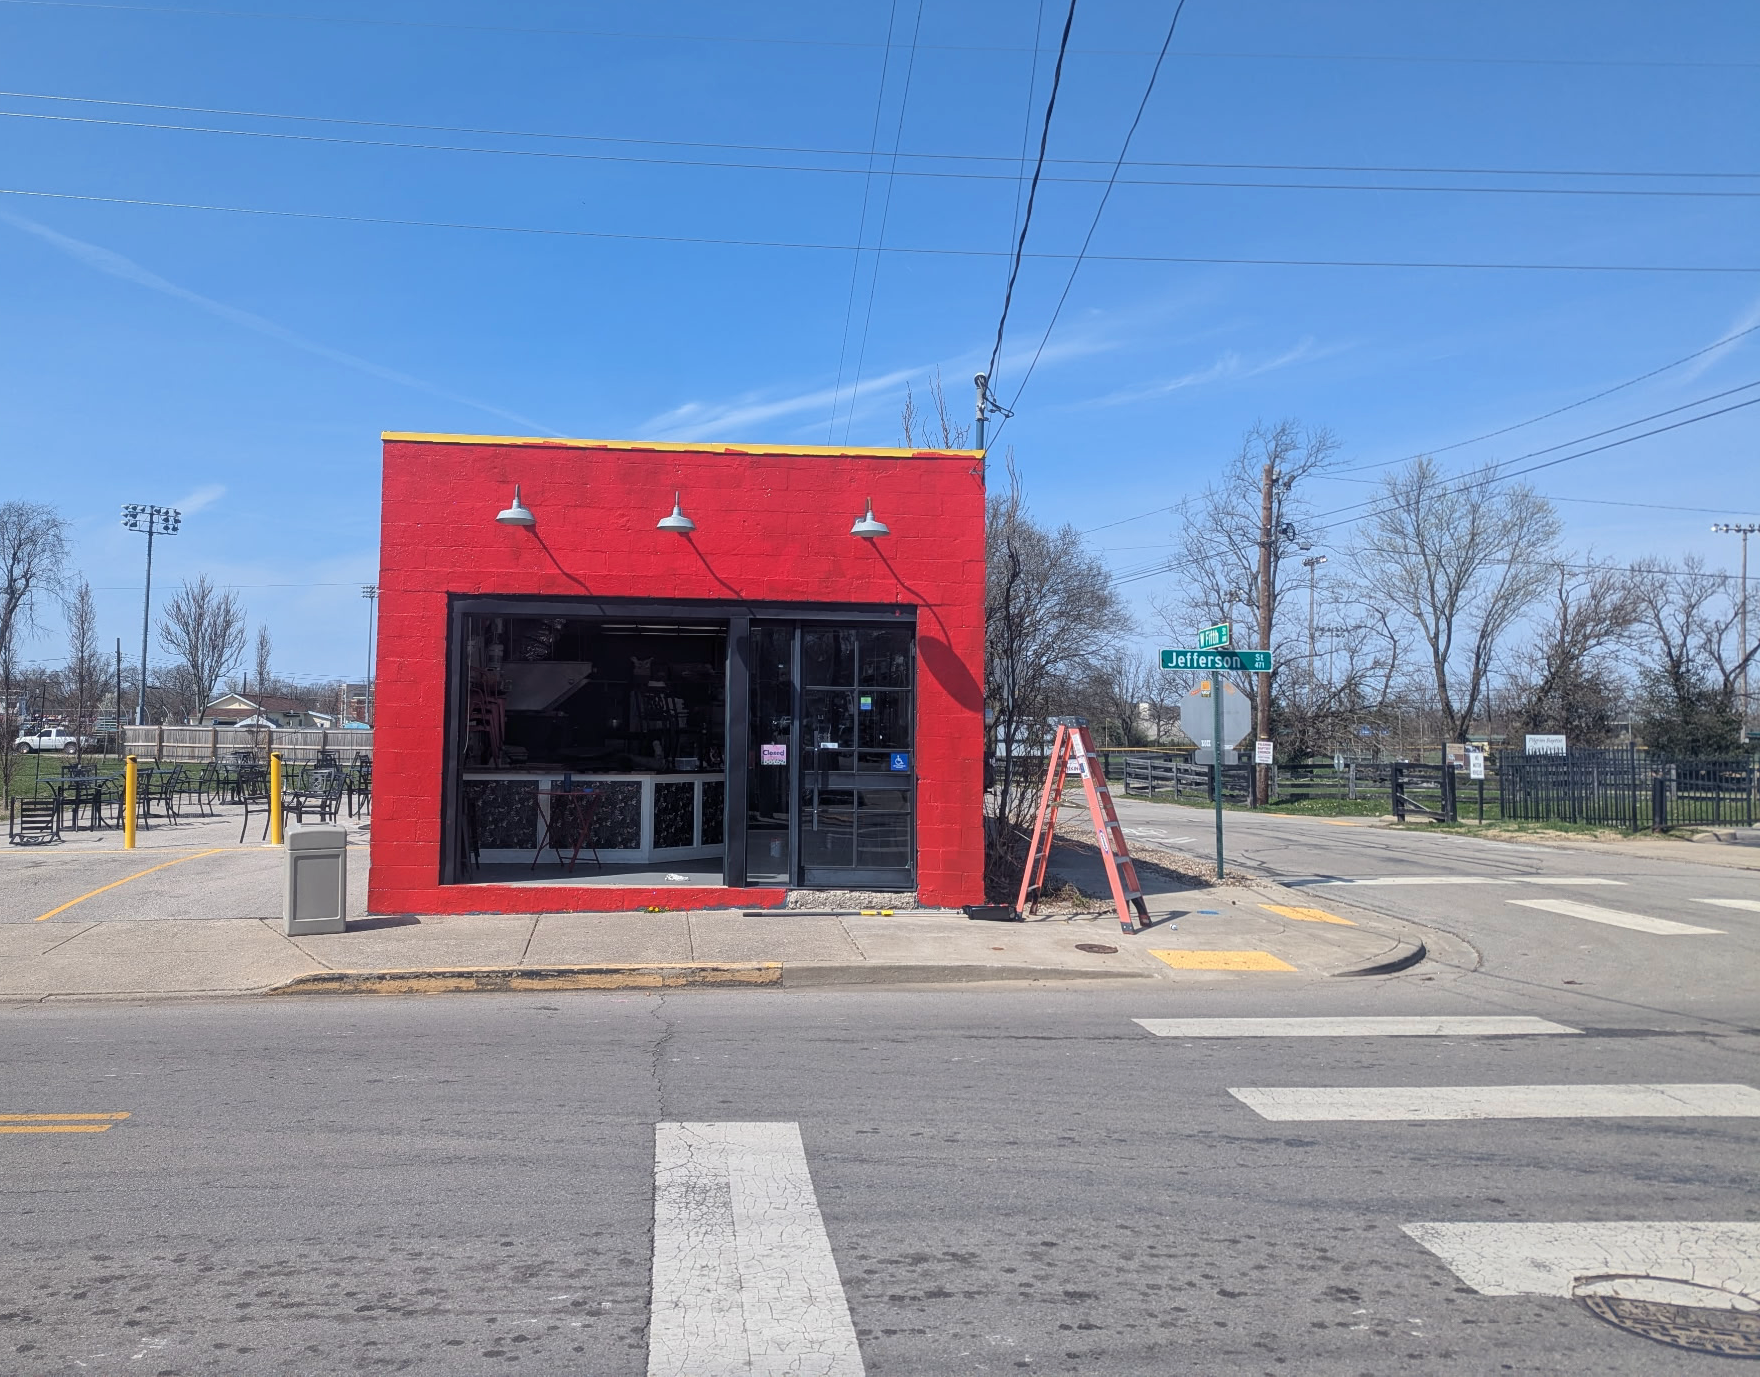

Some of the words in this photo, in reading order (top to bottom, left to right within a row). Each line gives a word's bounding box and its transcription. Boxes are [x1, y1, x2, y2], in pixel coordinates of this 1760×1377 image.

[1200, 632, 1205, 648] W
[1205, 629, 1219, 646] Fifth
[1167, 651, 1241, 668] Jefferson
[1255, 653, 1264, 661] St
[1528, 737, 1545, 745] Pilgrim
[1546, 737, 1563, 745] Baptist
